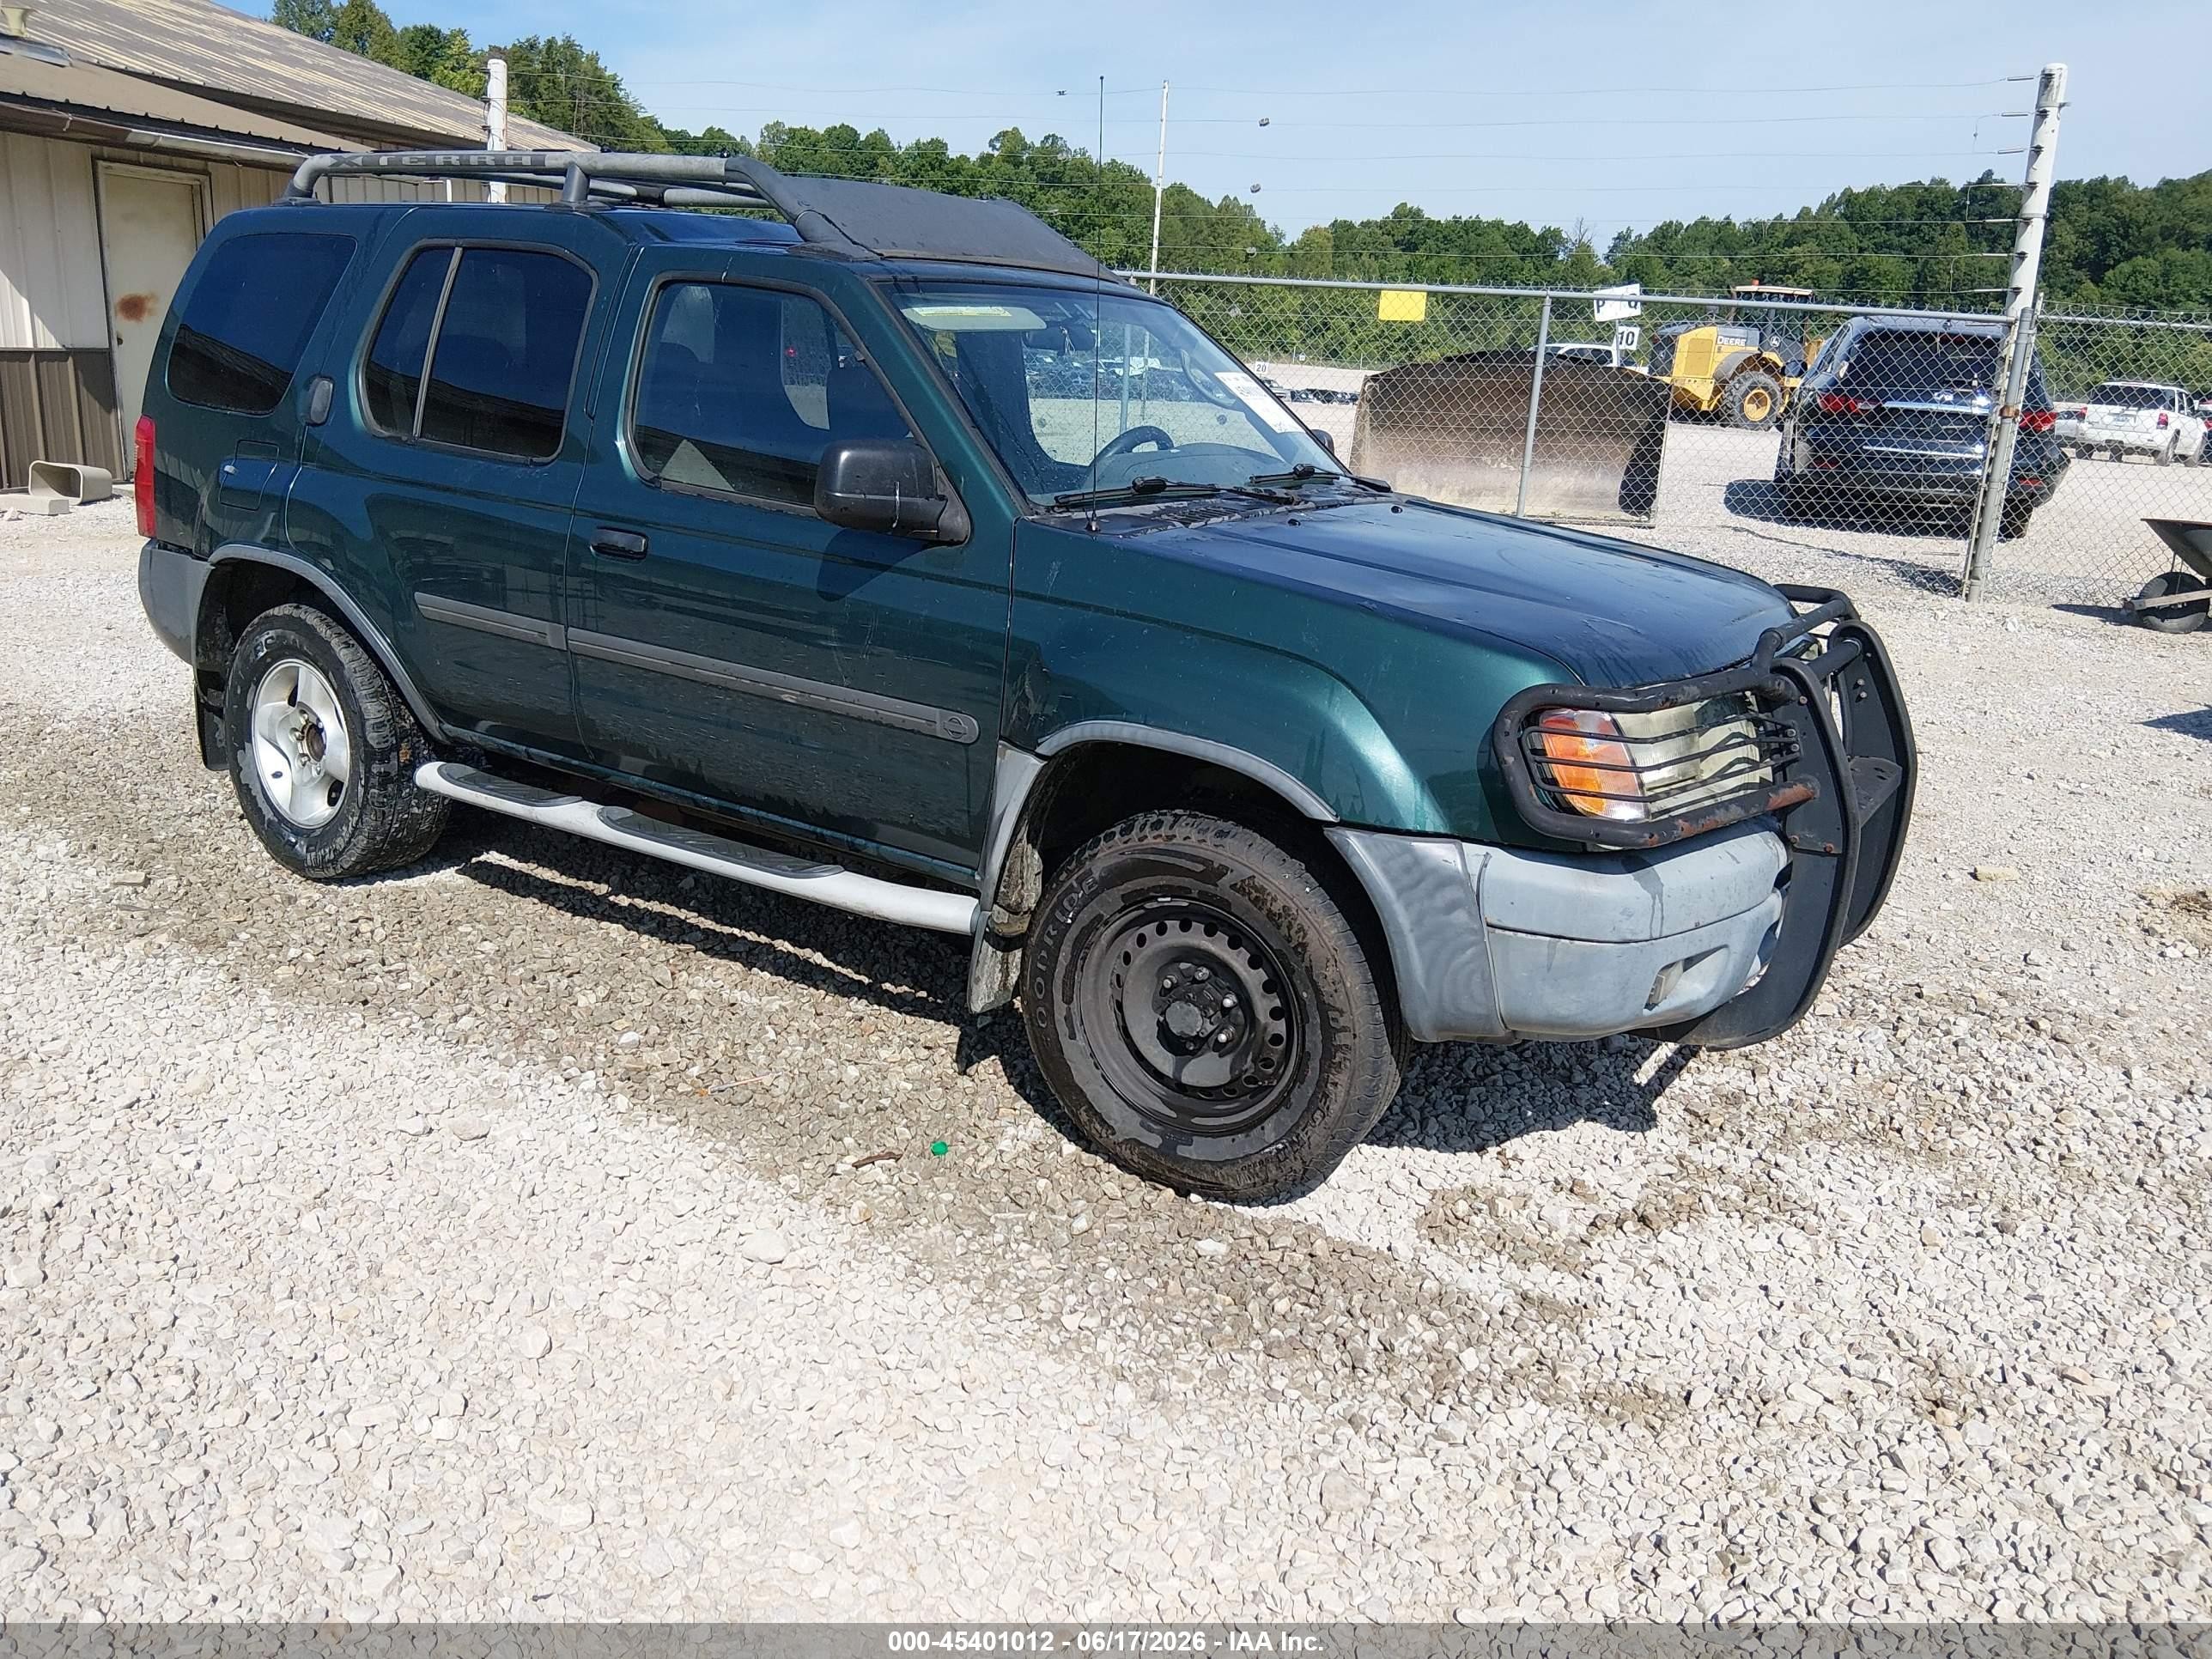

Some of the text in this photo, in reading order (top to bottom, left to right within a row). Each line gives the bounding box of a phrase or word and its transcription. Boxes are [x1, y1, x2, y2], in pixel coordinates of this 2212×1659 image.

[329, 154, 532, 167] XTERRA
[1618, 331, 1635, 346] 10
[1717, 335, 1747, 347] DEERE
[1256, 363, 1267, 373] 20
[1035, 875, 1098, 1045] OODRIDE
